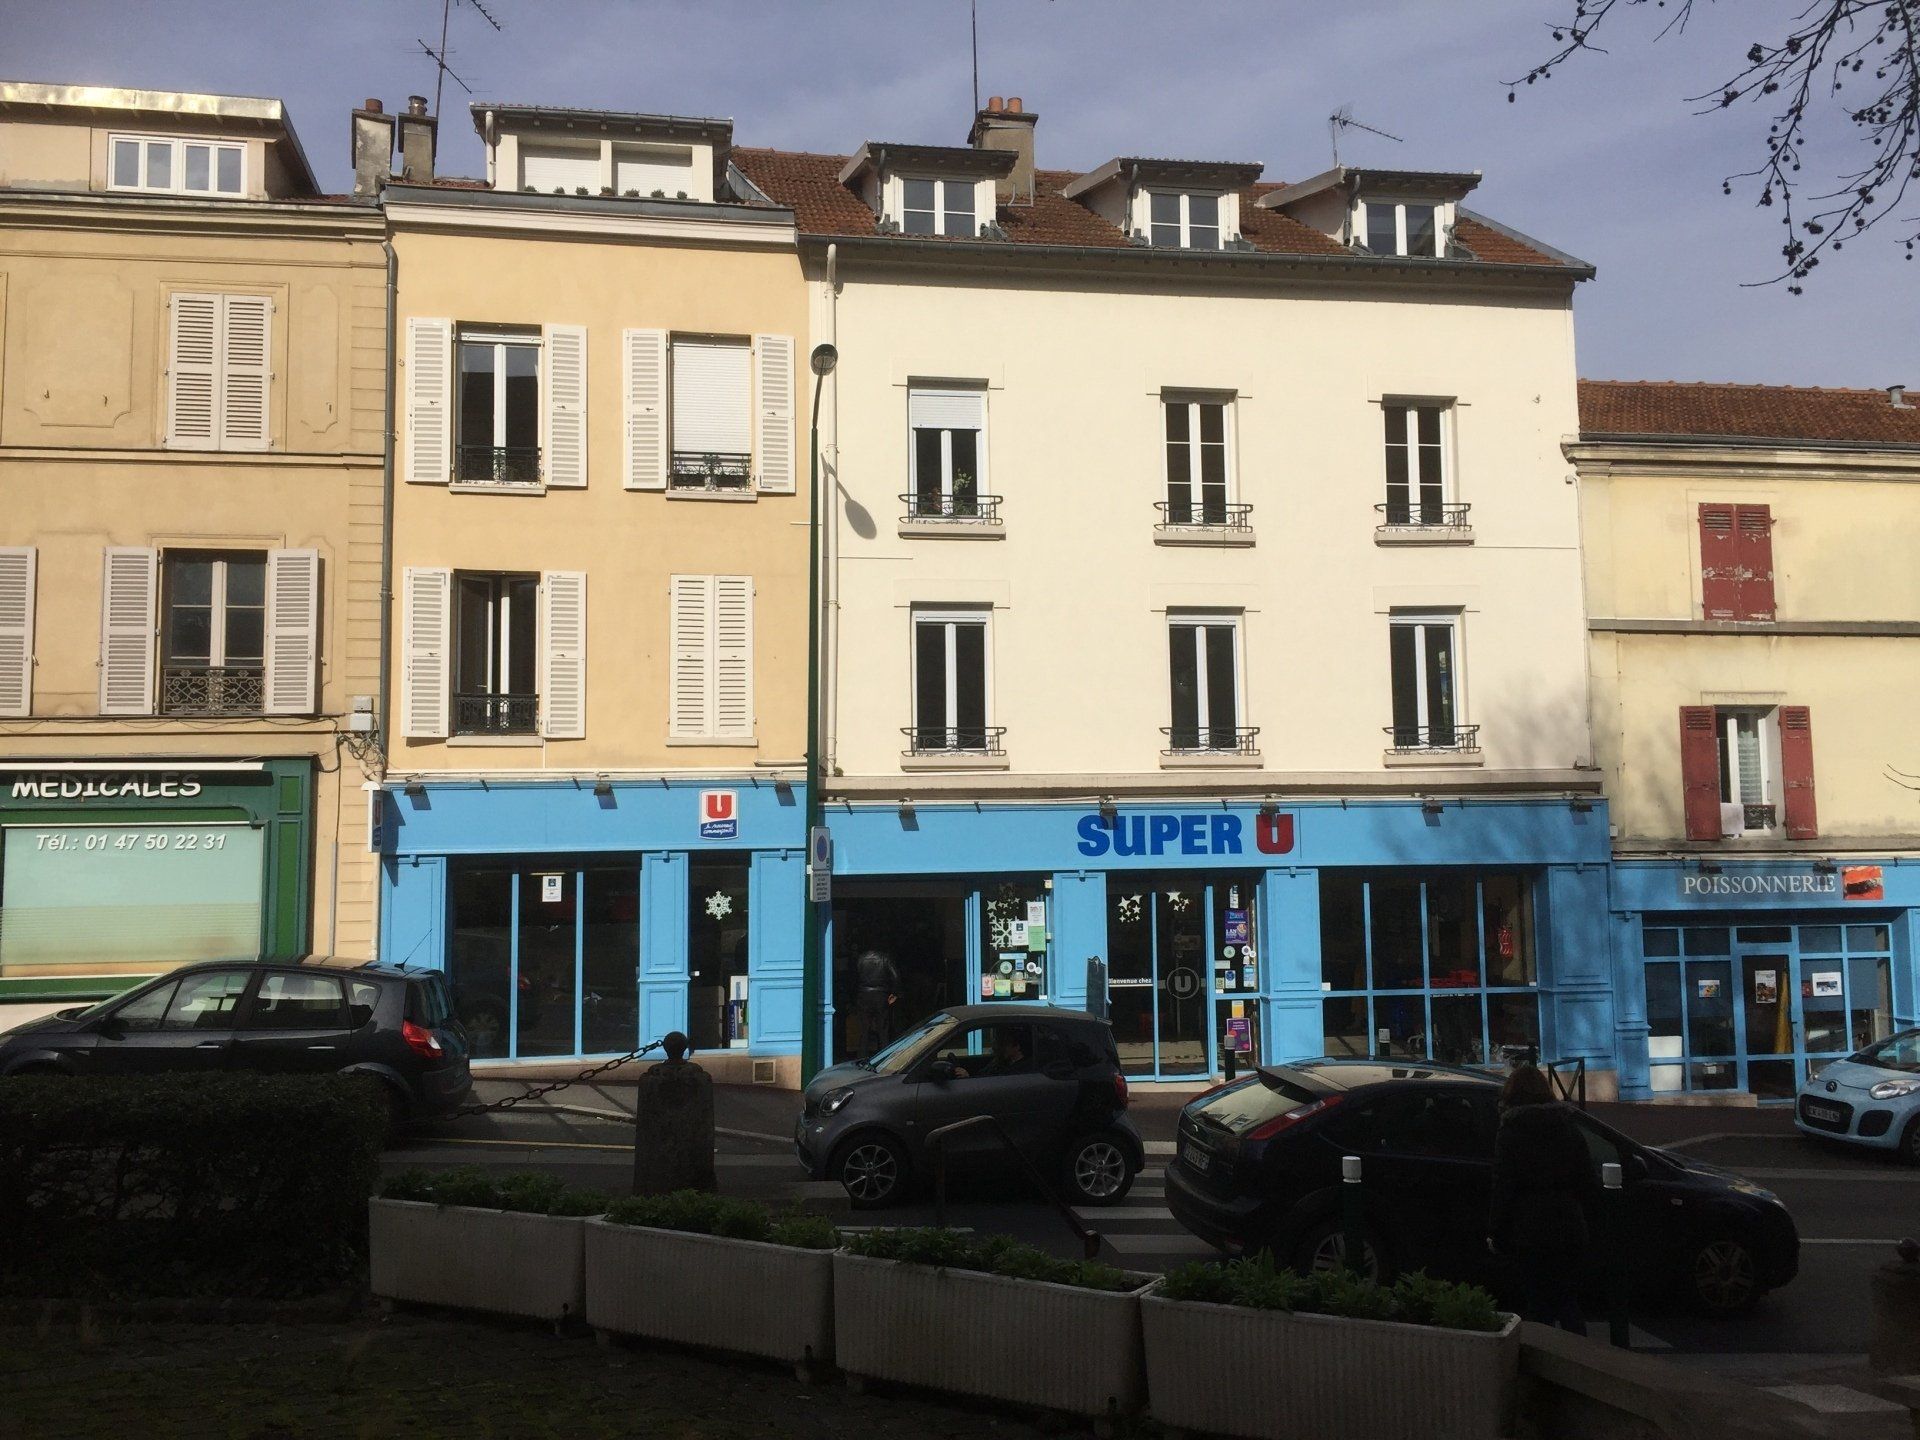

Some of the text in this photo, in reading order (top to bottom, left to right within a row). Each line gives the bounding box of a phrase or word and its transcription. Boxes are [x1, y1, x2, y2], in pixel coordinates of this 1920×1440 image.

[12, 771, 202, 798] MEDICALES
[707, 795, 732, 818] U
[85, 835, 108, 850] 01
[115, 834, 139, 850] 47
[144, 834, 168, 850] 50
[175, 834, 198, 850] 22
[203, 834, 226, 850] 31
[1077, 813, 1294, 857] SUPER U
[1684, 875, 1836, 894] POISSONNERIE
